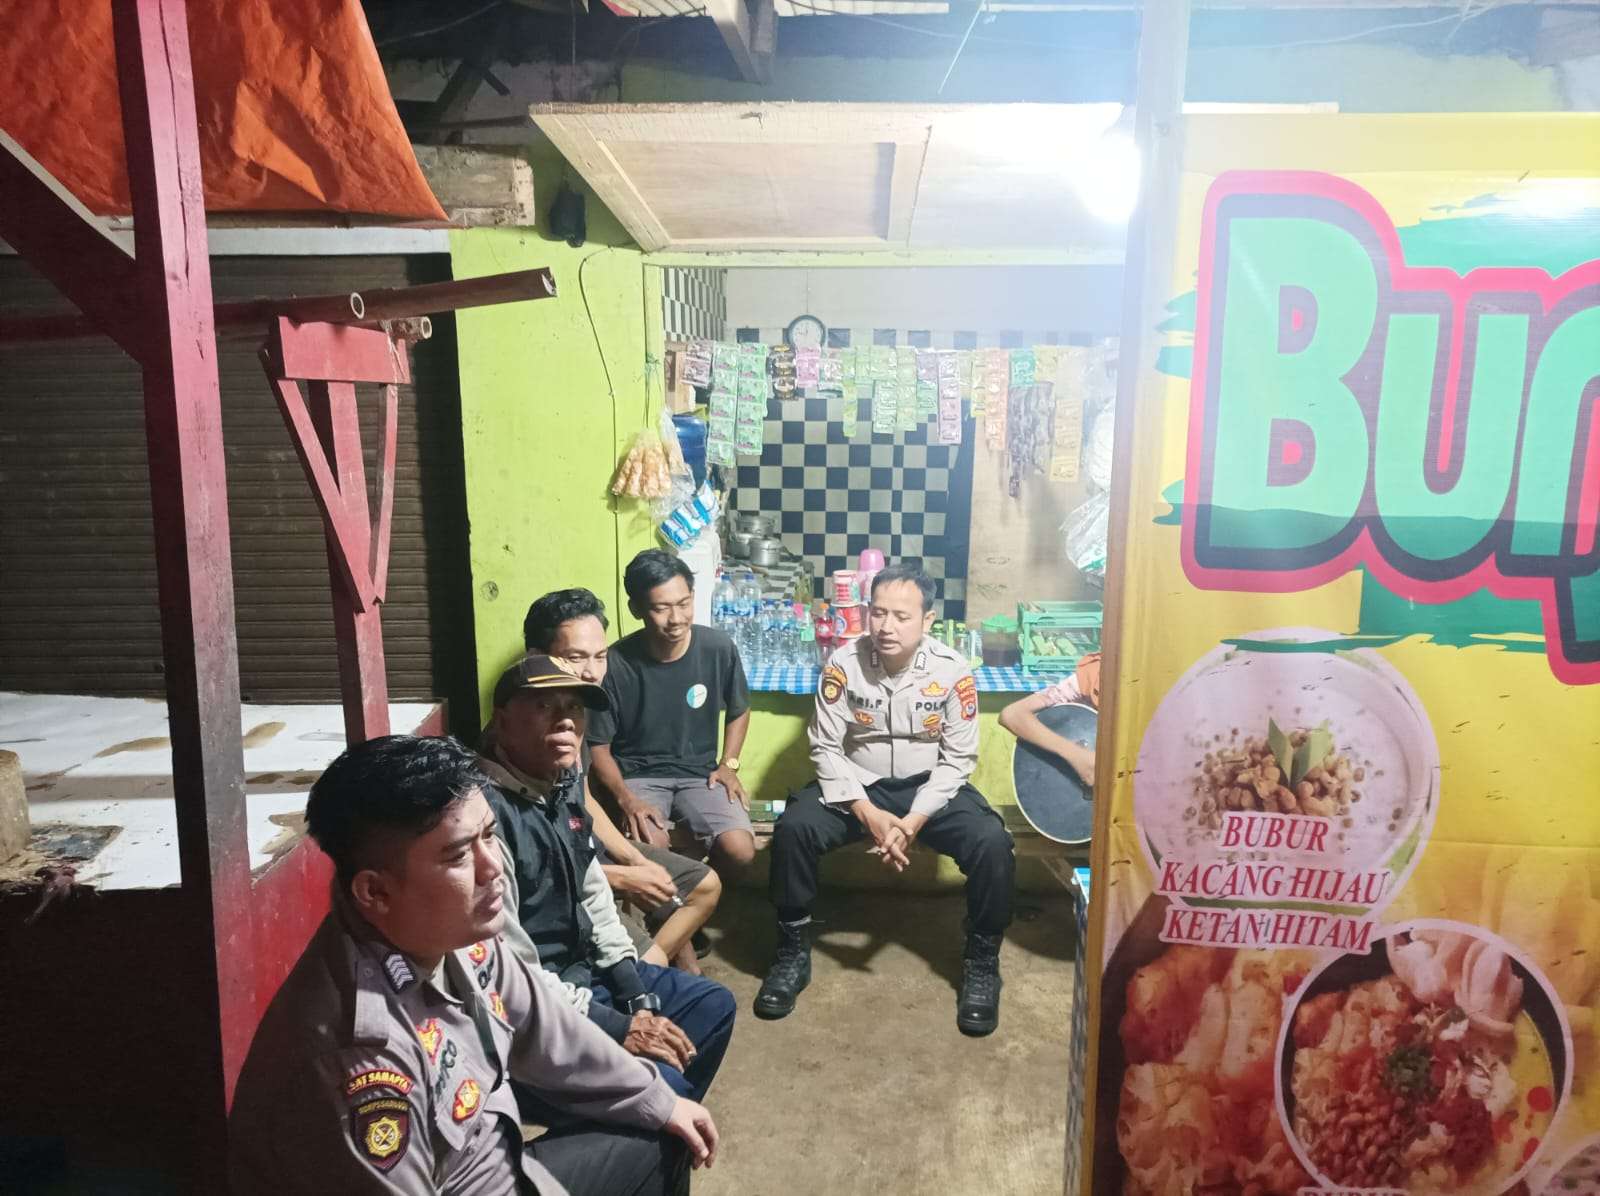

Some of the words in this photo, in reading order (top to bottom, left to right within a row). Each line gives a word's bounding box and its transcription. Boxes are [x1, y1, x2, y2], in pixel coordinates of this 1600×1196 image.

[1190, 185, 1600, 665] Bur
[1222, 815, 1329, 852] BUBUR
[1159, 861, 1284, 898] KACANG
[1288, 866, 1390, 904] HIJAU
[1166, 909, 1265, 944] KETAN
[1270, 914, 1374, 951] HITAM
